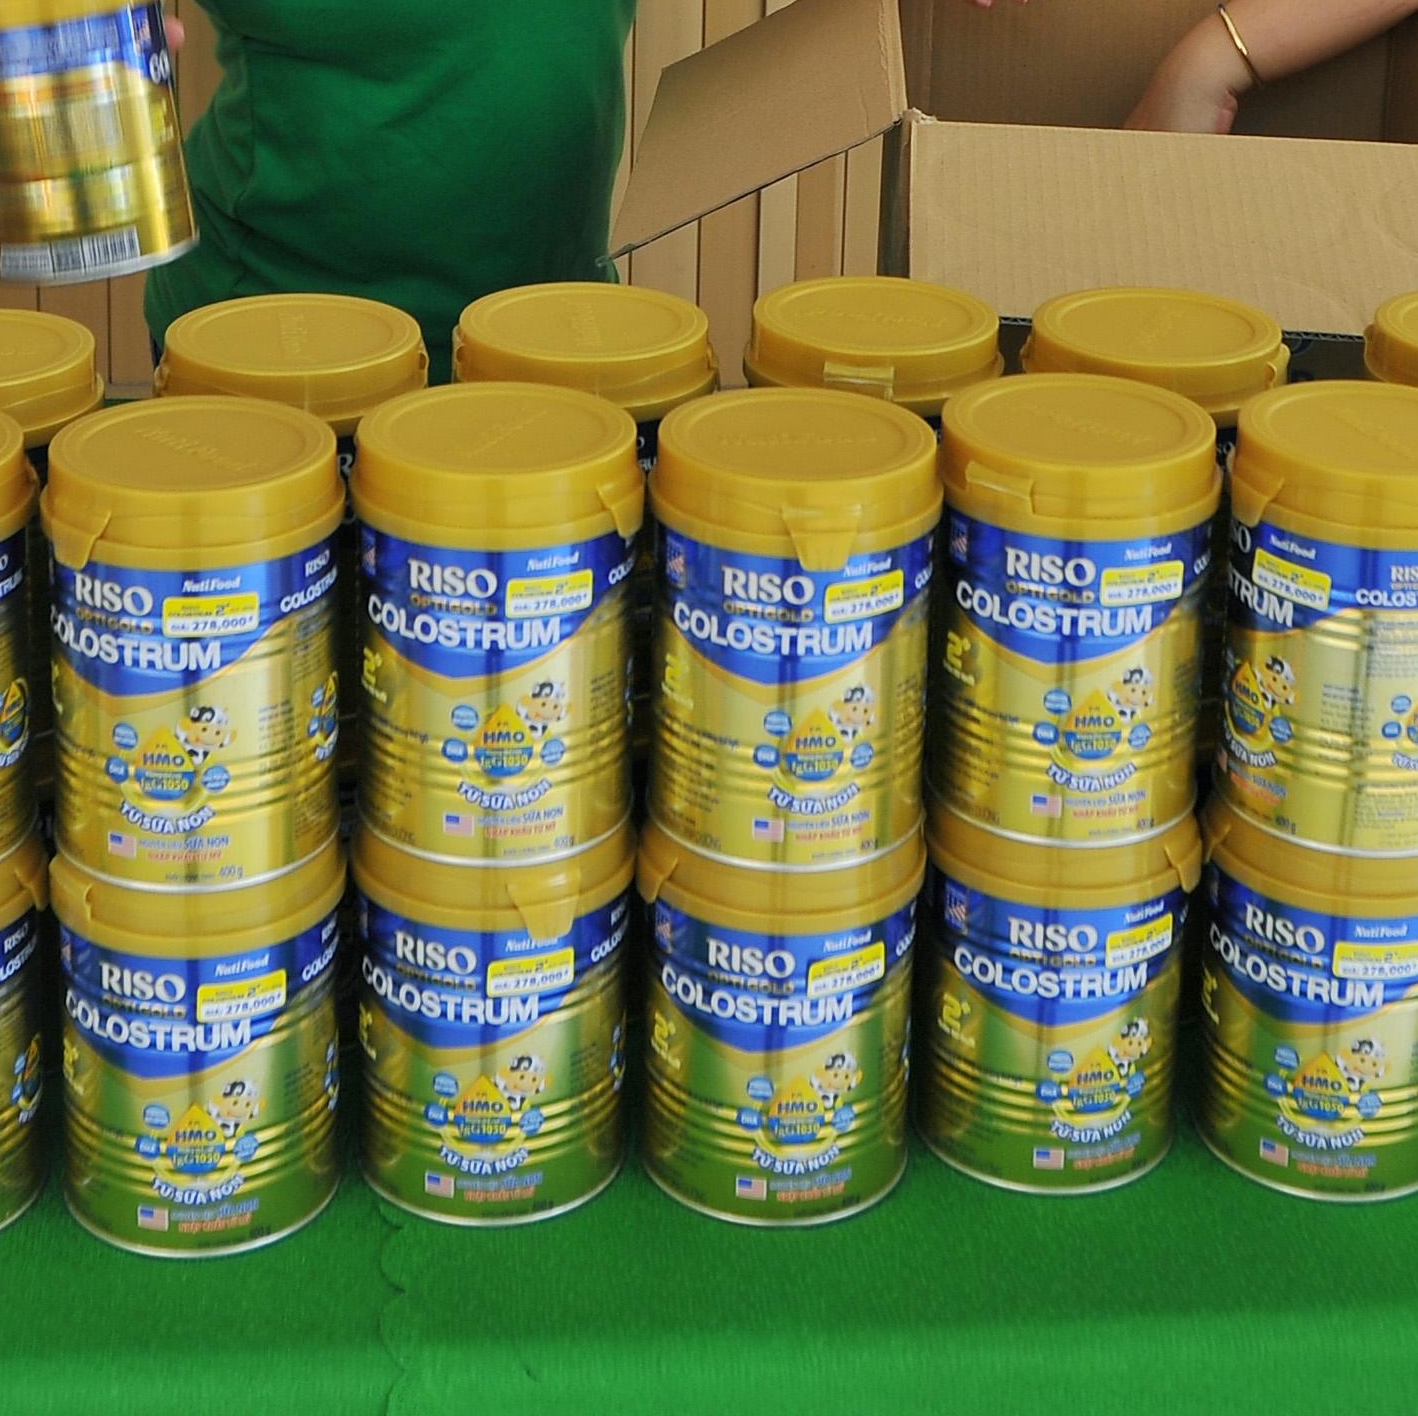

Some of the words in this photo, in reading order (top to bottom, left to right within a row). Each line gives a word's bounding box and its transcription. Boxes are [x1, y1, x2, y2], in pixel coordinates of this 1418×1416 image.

[408, 557, 497, 598] RISO
[722, 565, 815, 605] RISO
[1006, 546, 1096, 586] RISO
[73, 571, 154, 617] RISO
[956, 580, 1153, 637] COLOSTRUM
[368, 595, 561, 651] COLOSTRUM
[673, 601, 874, 657] COLOSTRUM
[395, 931, 477, 975] RISO
[1008, 916, 1098, 951] RISO
[1245, 902, 1325, 955] RISO
[100, 961, 186, 1003] RISO
[707, 937, 796, 979] RISO
[954, 946, 1148, 1000] COLOSTRUM
[1209, 923, 1385, 1008] COLOSTRUM
[361, 956, 540, 1025] COLOSTRUM
[662, 966, 854, 1027] COLOSTRUM
[66, 990, 251, 1052] COLOSTRUM
